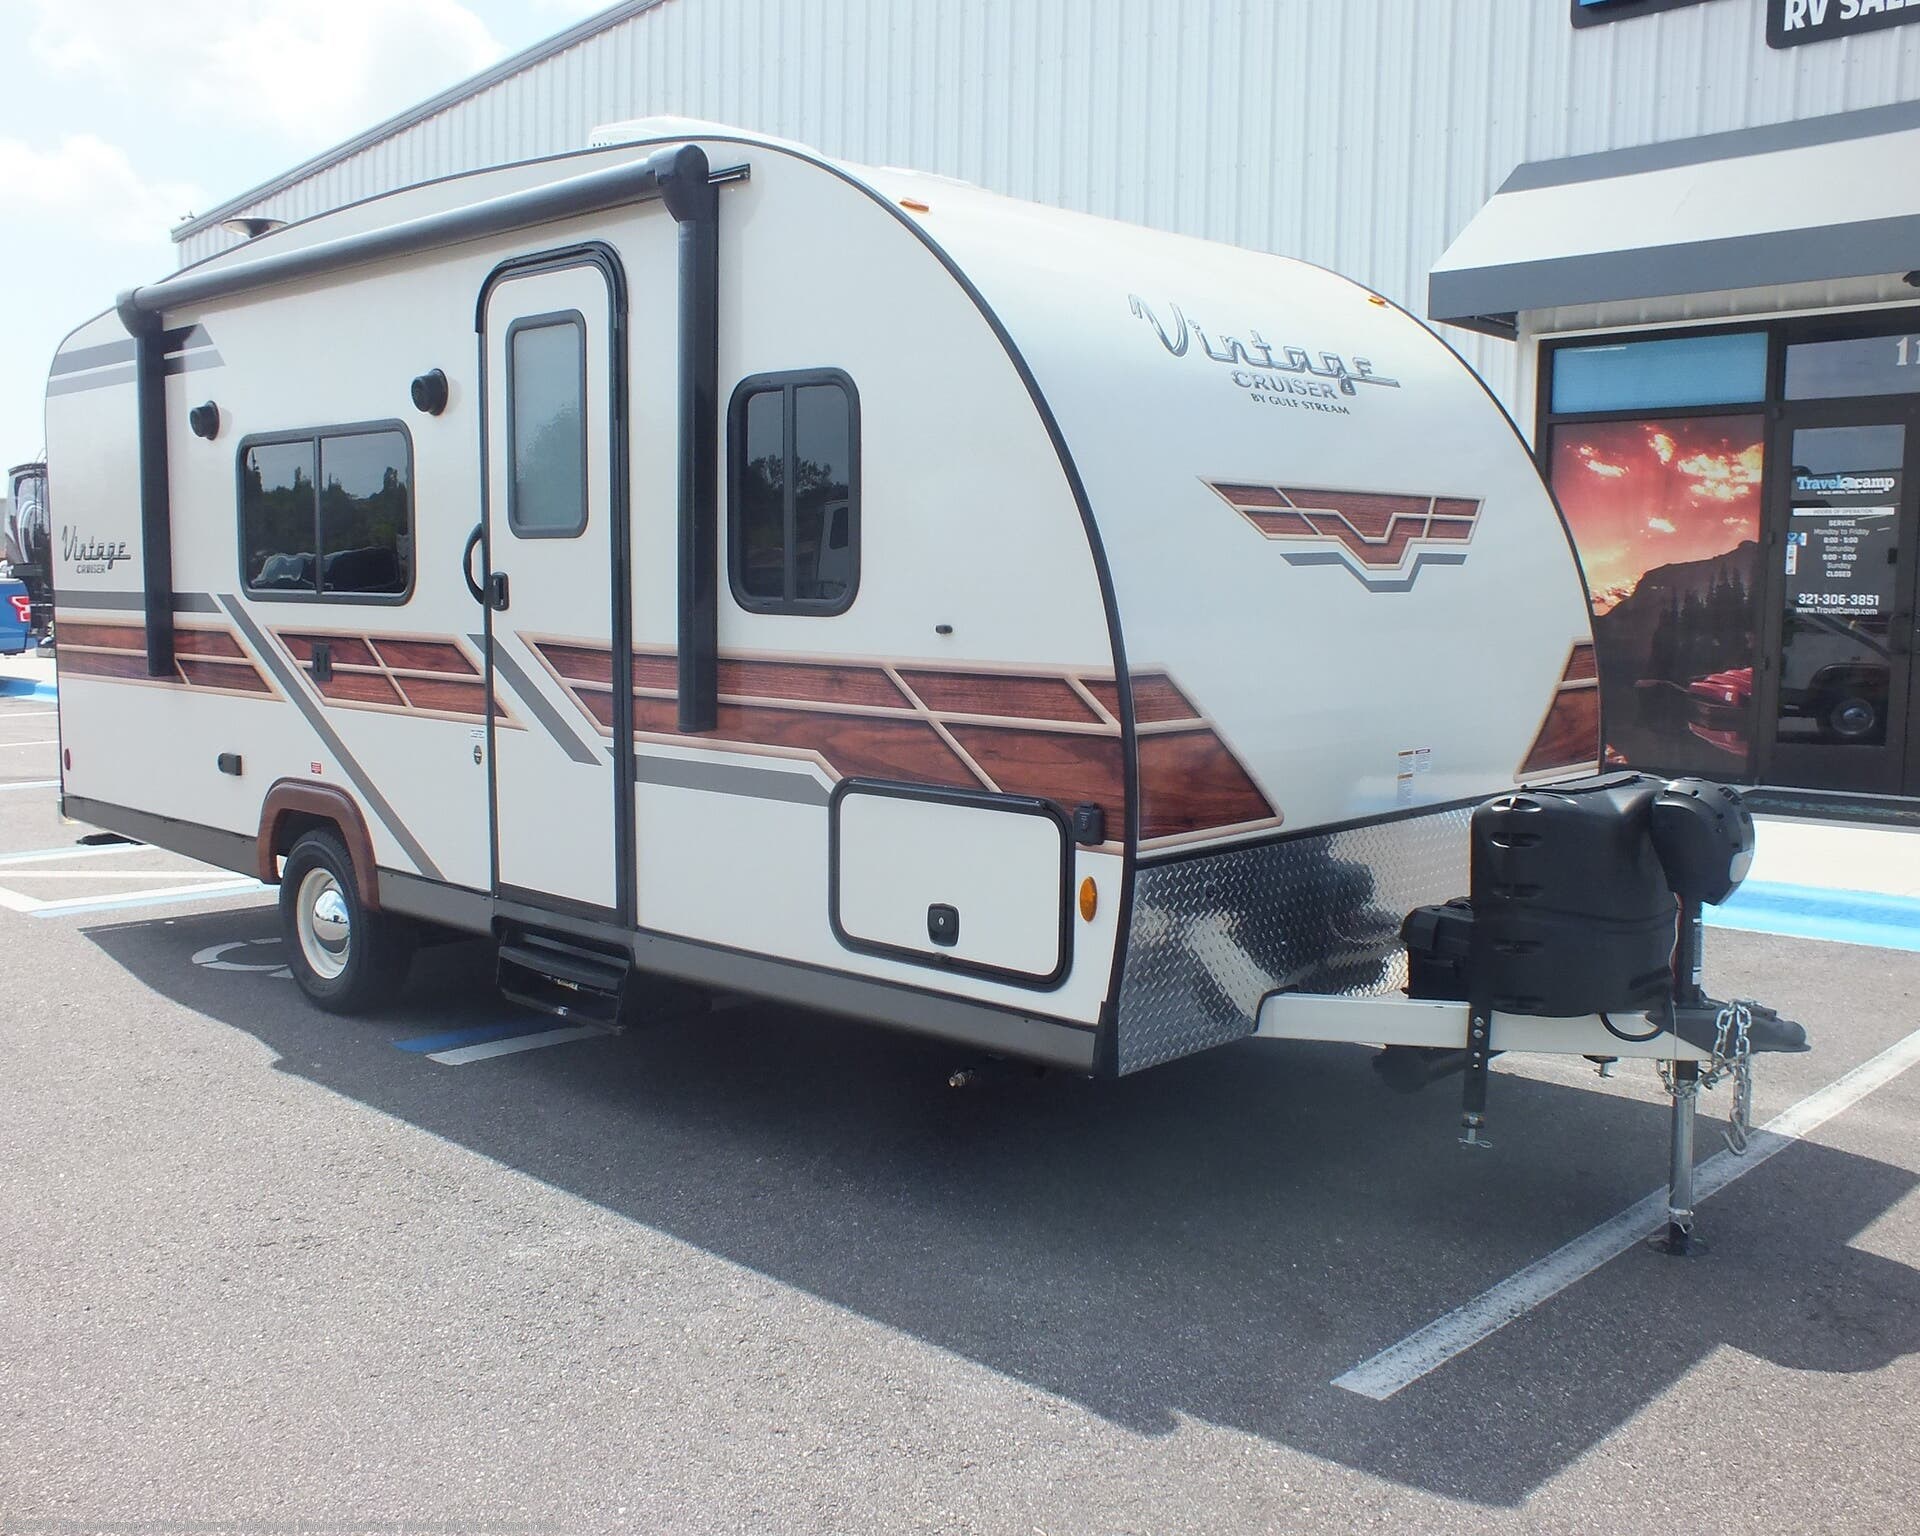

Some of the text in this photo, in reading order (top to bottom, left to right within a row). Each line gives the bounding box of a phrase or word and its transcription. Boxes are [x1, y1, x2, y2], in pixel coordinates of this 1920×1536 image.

[1783, 0, 1828, 31] RV
[1127, 293, 1401, 397] Vintage
[1231, 369, 1339, 400] CRUISER
[1250, 392, 1351, 416] BY GULF STREAM
[1813, 528, 1839, 536] Monday
[1849, 528, 1870, 537] Friday
[61, 525, 132, 571] Vintage
[76, 564, 106, 575] CRUISER
[1796, 606, 1878, 615] www.TravelCamp.com
[1798, 593, 1879, 605] 321-306-3851
